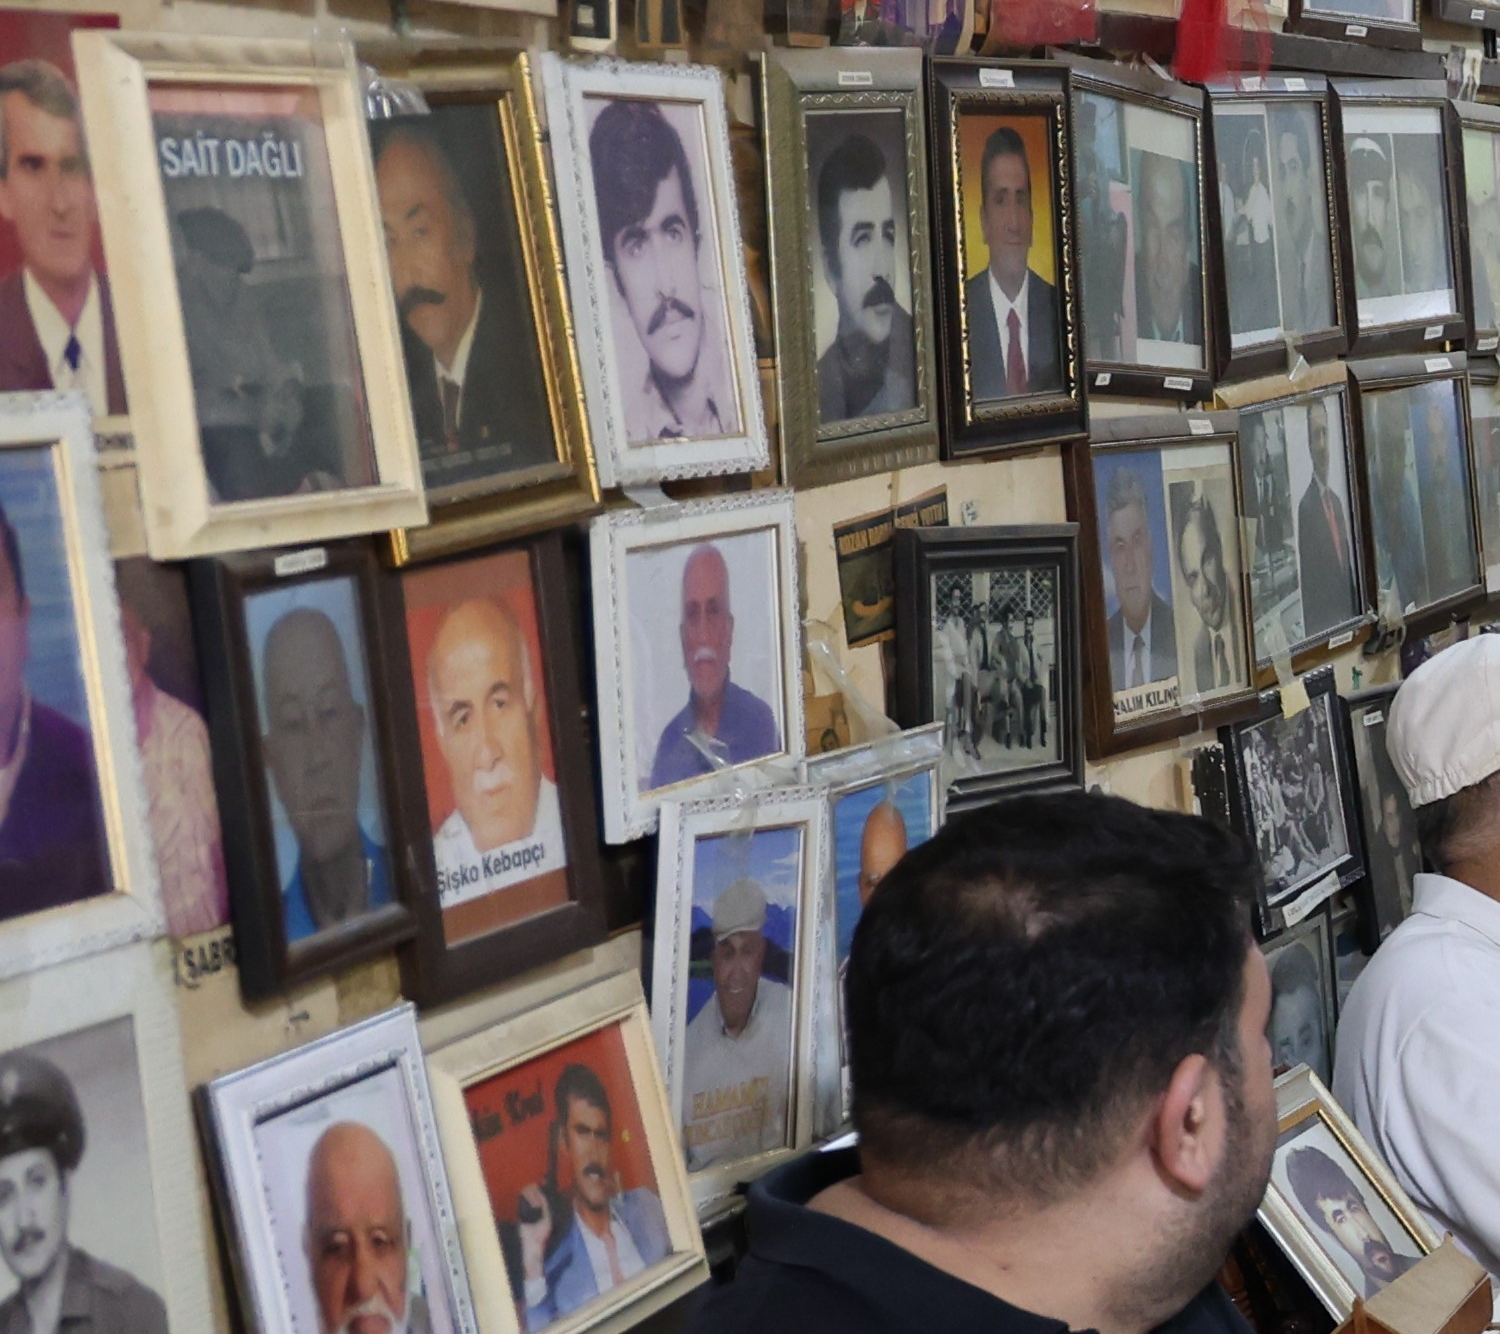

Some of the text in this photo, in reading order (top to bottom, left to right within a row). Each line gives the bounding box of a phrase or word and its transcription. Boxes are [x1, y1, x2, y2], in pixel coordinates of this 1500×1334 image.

[160, 130, 303, 178] SAİT DAĞLI
[436, 843, 547, 899] Şişko Kebapçı
